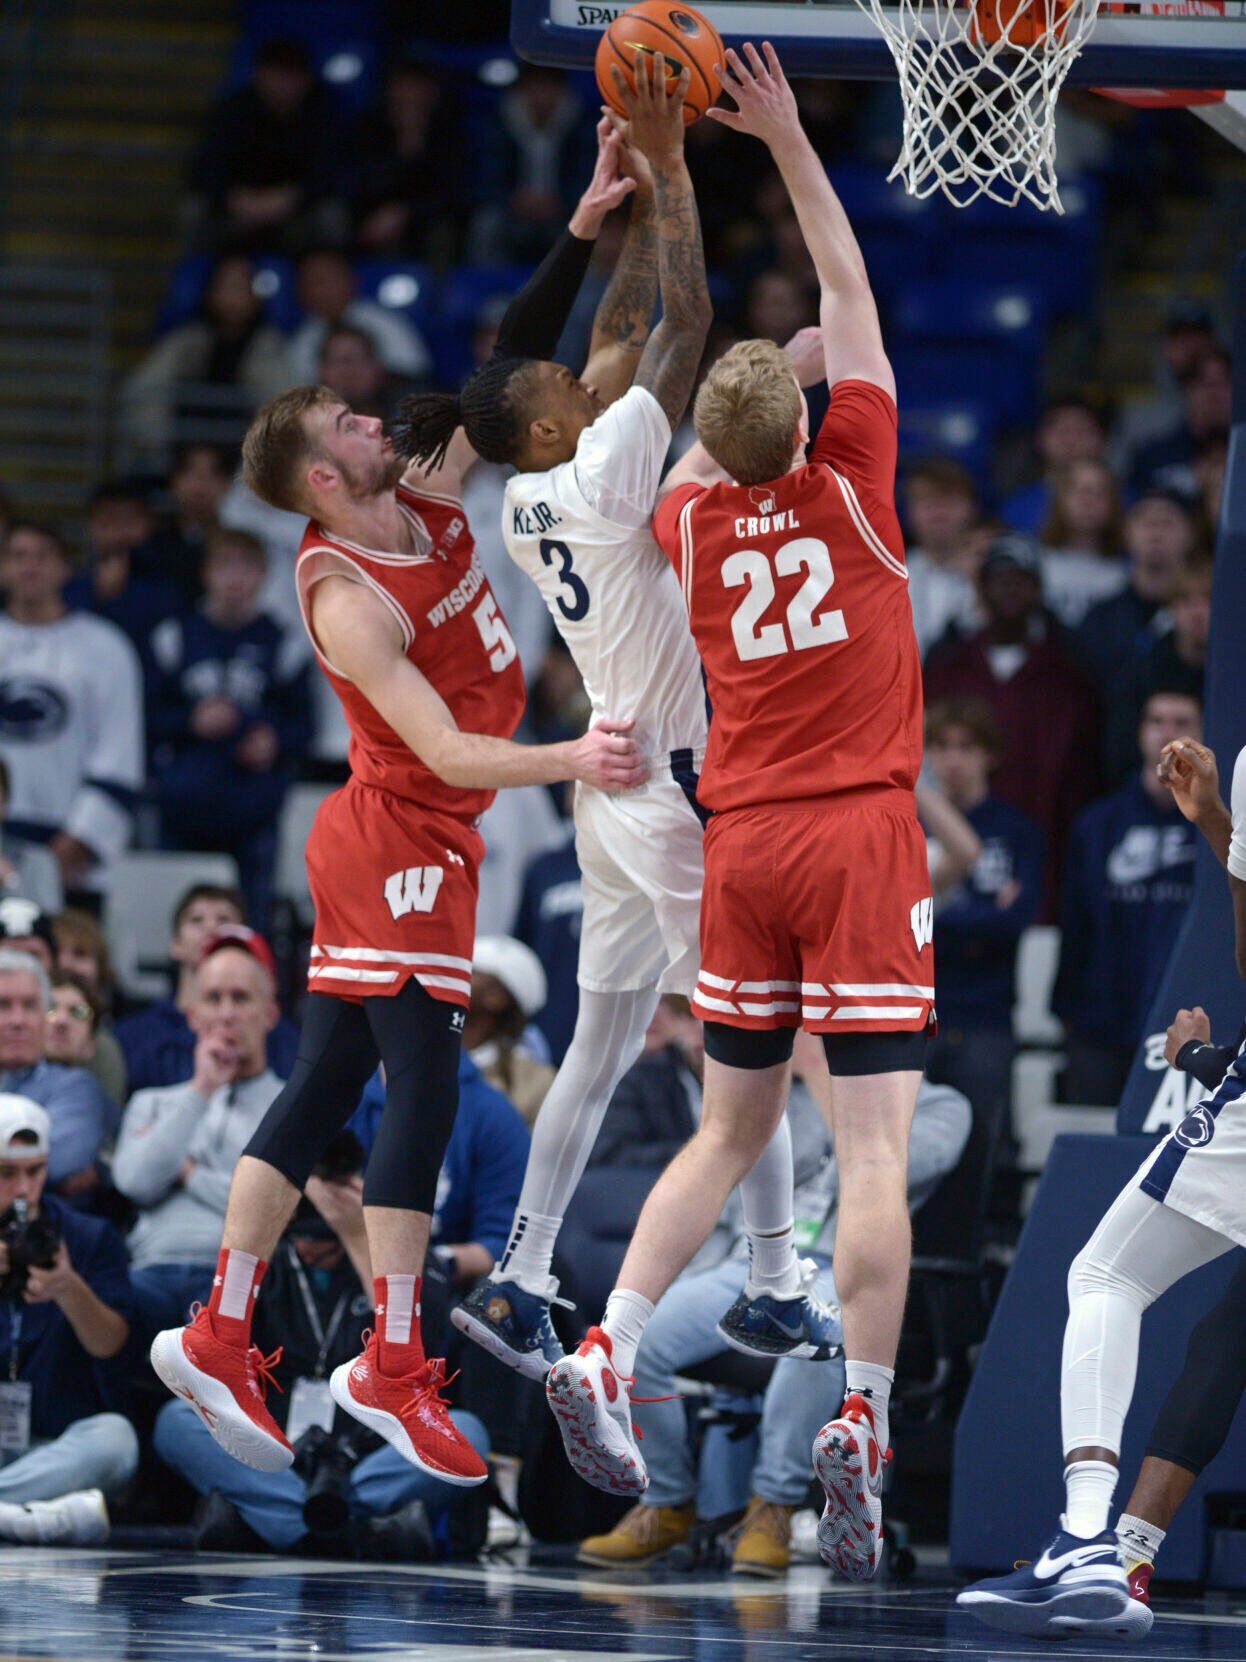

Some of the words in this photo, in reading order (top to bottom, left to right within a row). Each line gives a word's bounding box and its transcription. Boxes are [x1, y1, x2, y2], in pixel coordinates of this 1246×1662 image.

[734, 508, 800, 539] CROWL
[539, 537, 590, 622] 3
[720, 536, 850, 662] 22
[471, 590, 517, 673] 5
[384, 865, 444, 921] W
